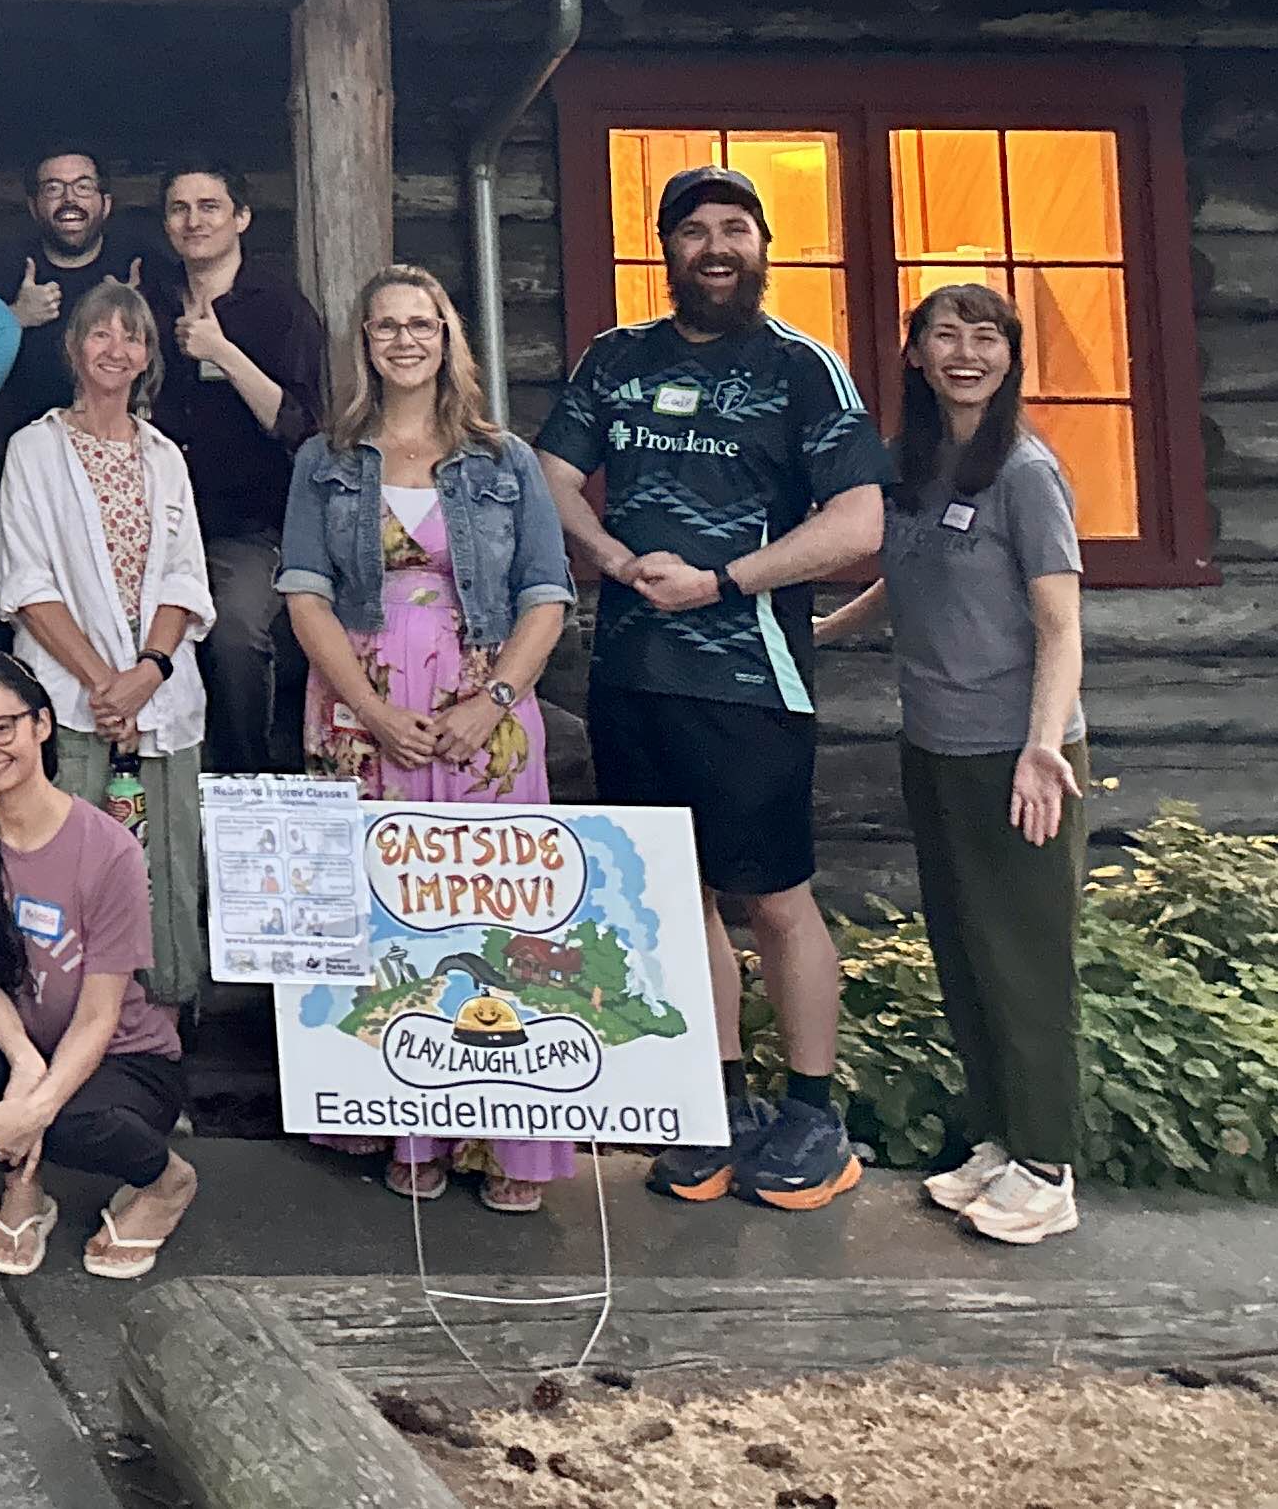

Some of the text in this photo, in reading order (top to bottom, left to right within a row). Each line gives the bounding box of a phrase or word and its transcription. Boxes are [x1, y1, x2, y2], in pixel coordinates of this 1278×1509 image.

[634, 425, 741, 458] Providence
[306, 787, 349, 799] Classes
[375, 822, 564, 870] EASTSIDE
[397, 872, 555, 921] IMPROV!
[394, 1030, 592, 1076] PLAY, LAUGH, LEARN
[314, 1091, 681, 1142] EastsideImprov.org
